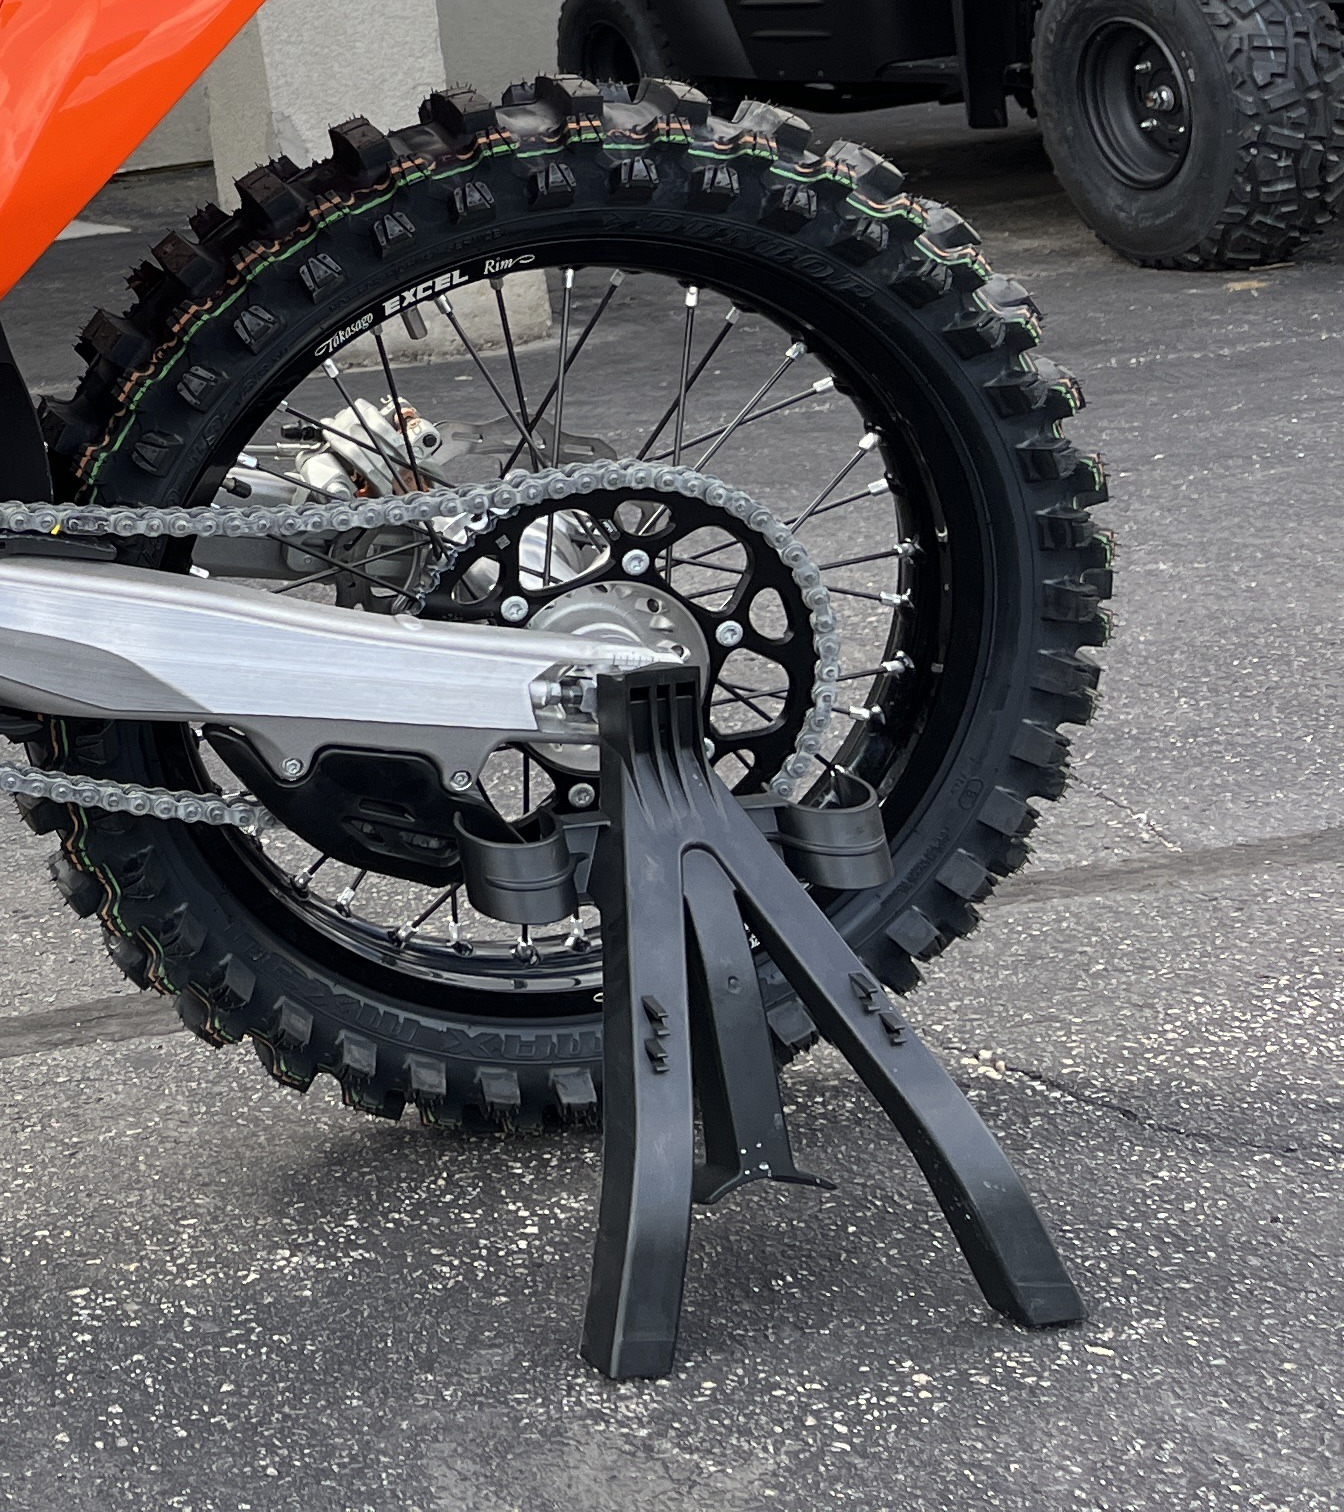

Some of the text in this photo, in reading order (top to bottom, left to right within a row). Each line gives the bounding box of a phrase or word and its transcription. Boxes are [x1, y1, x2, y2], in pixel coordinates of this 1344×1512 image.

[314, 313, 374, 357] Takasago
[382, 269, 469, 316] EXCEL
[484, 254, 529, 275] Rim
